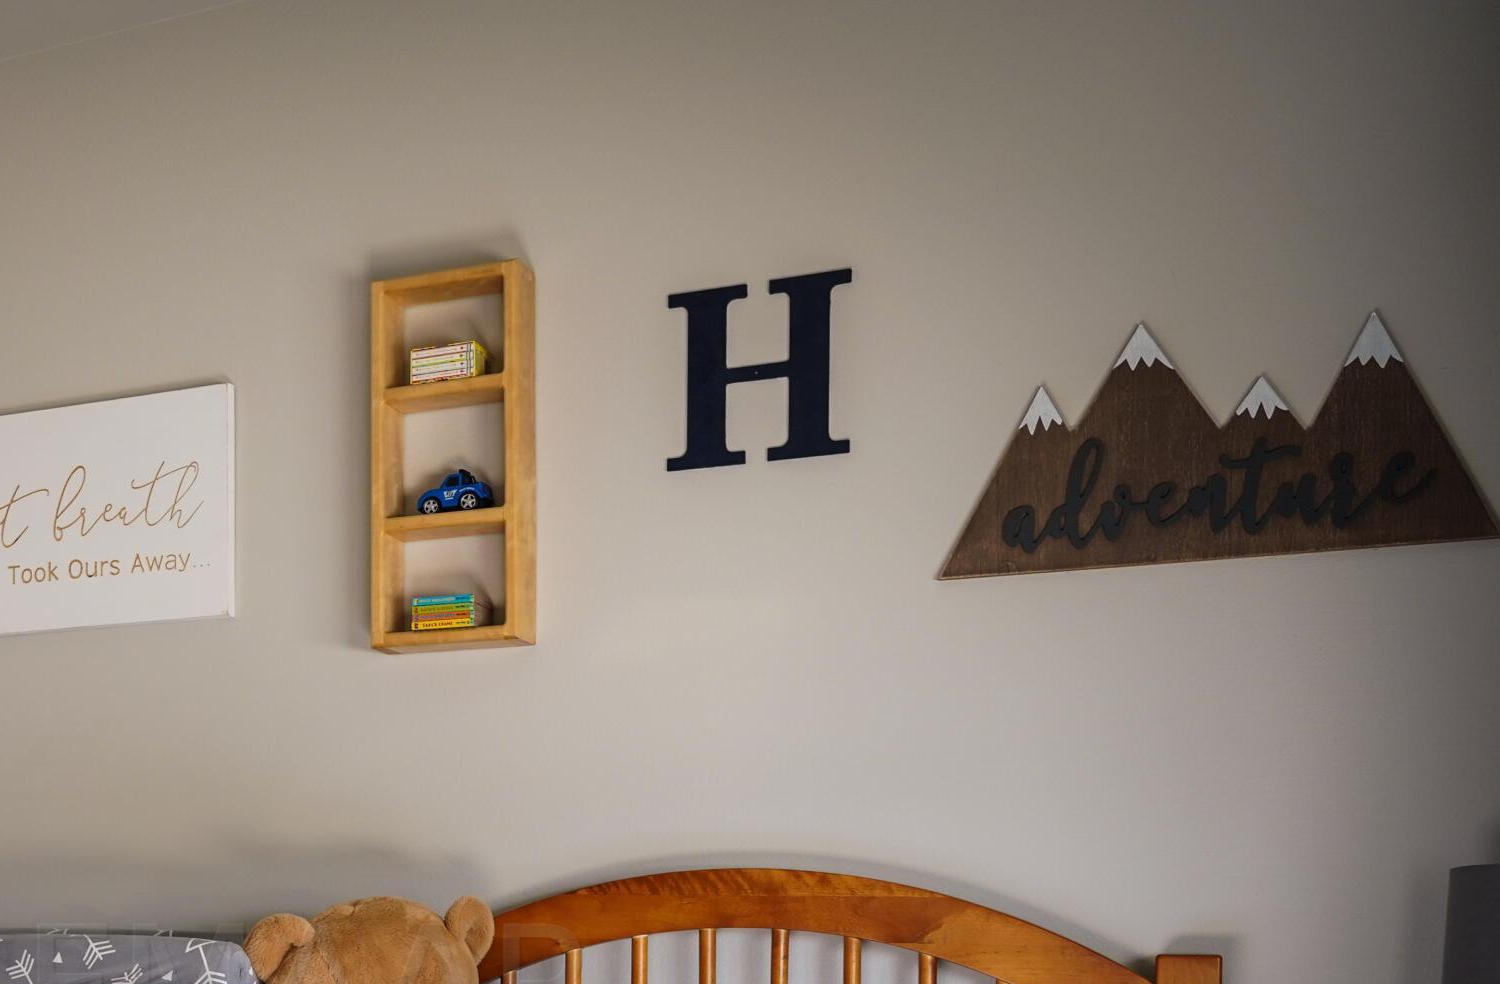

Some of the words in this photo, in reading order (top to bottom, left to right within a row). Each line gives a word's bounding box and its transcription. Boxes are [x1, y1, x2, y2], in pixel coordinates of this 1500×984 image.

[667, 268, 853, 471] H
[52, 460, 205, 542] breath
[1002, 436, 1438, 555] adventure
[7, 560, 60, 585] Took
[67, 556, 122, 581] Ours
